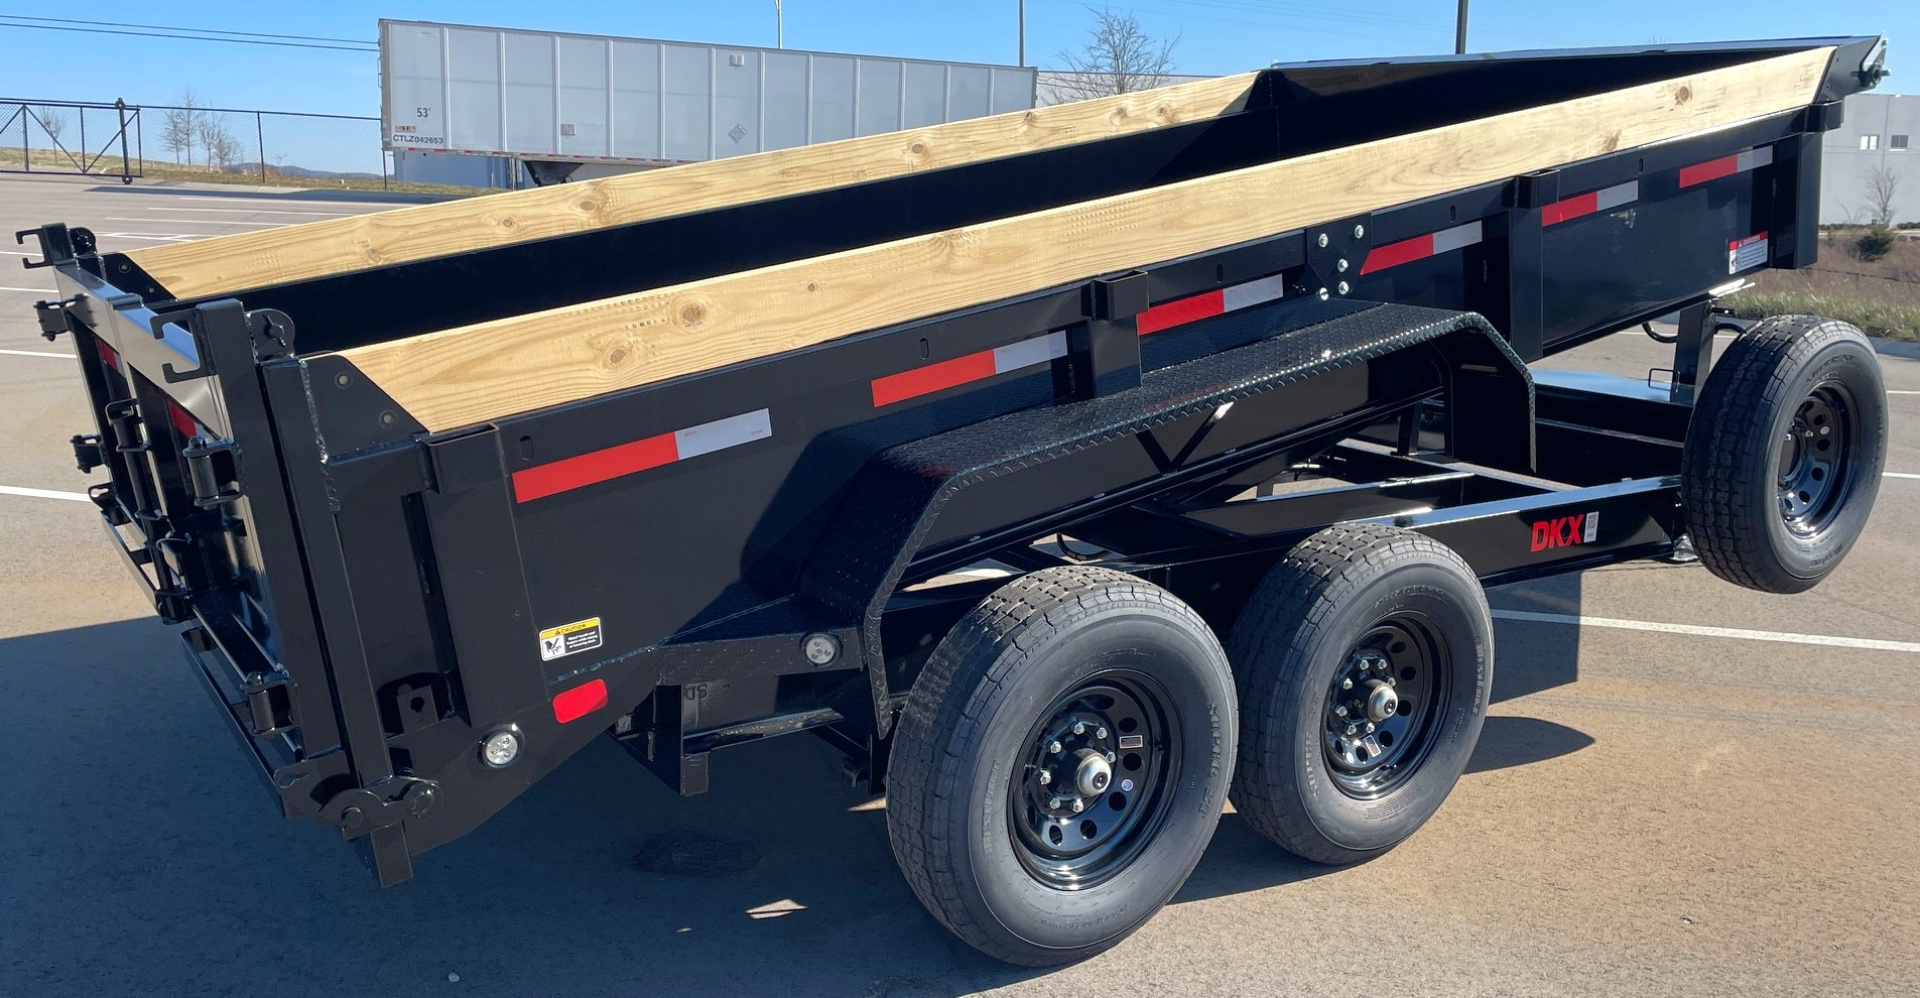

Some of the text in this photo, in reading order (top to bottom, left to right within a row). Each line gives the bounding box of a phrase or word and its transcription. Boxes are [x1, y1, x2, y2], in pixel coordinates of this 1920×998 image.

[417, 107, 431, 118] 53'
[1531, 515, 1585, 552] DKX
[561, 624, 587, 634] CAUTION
